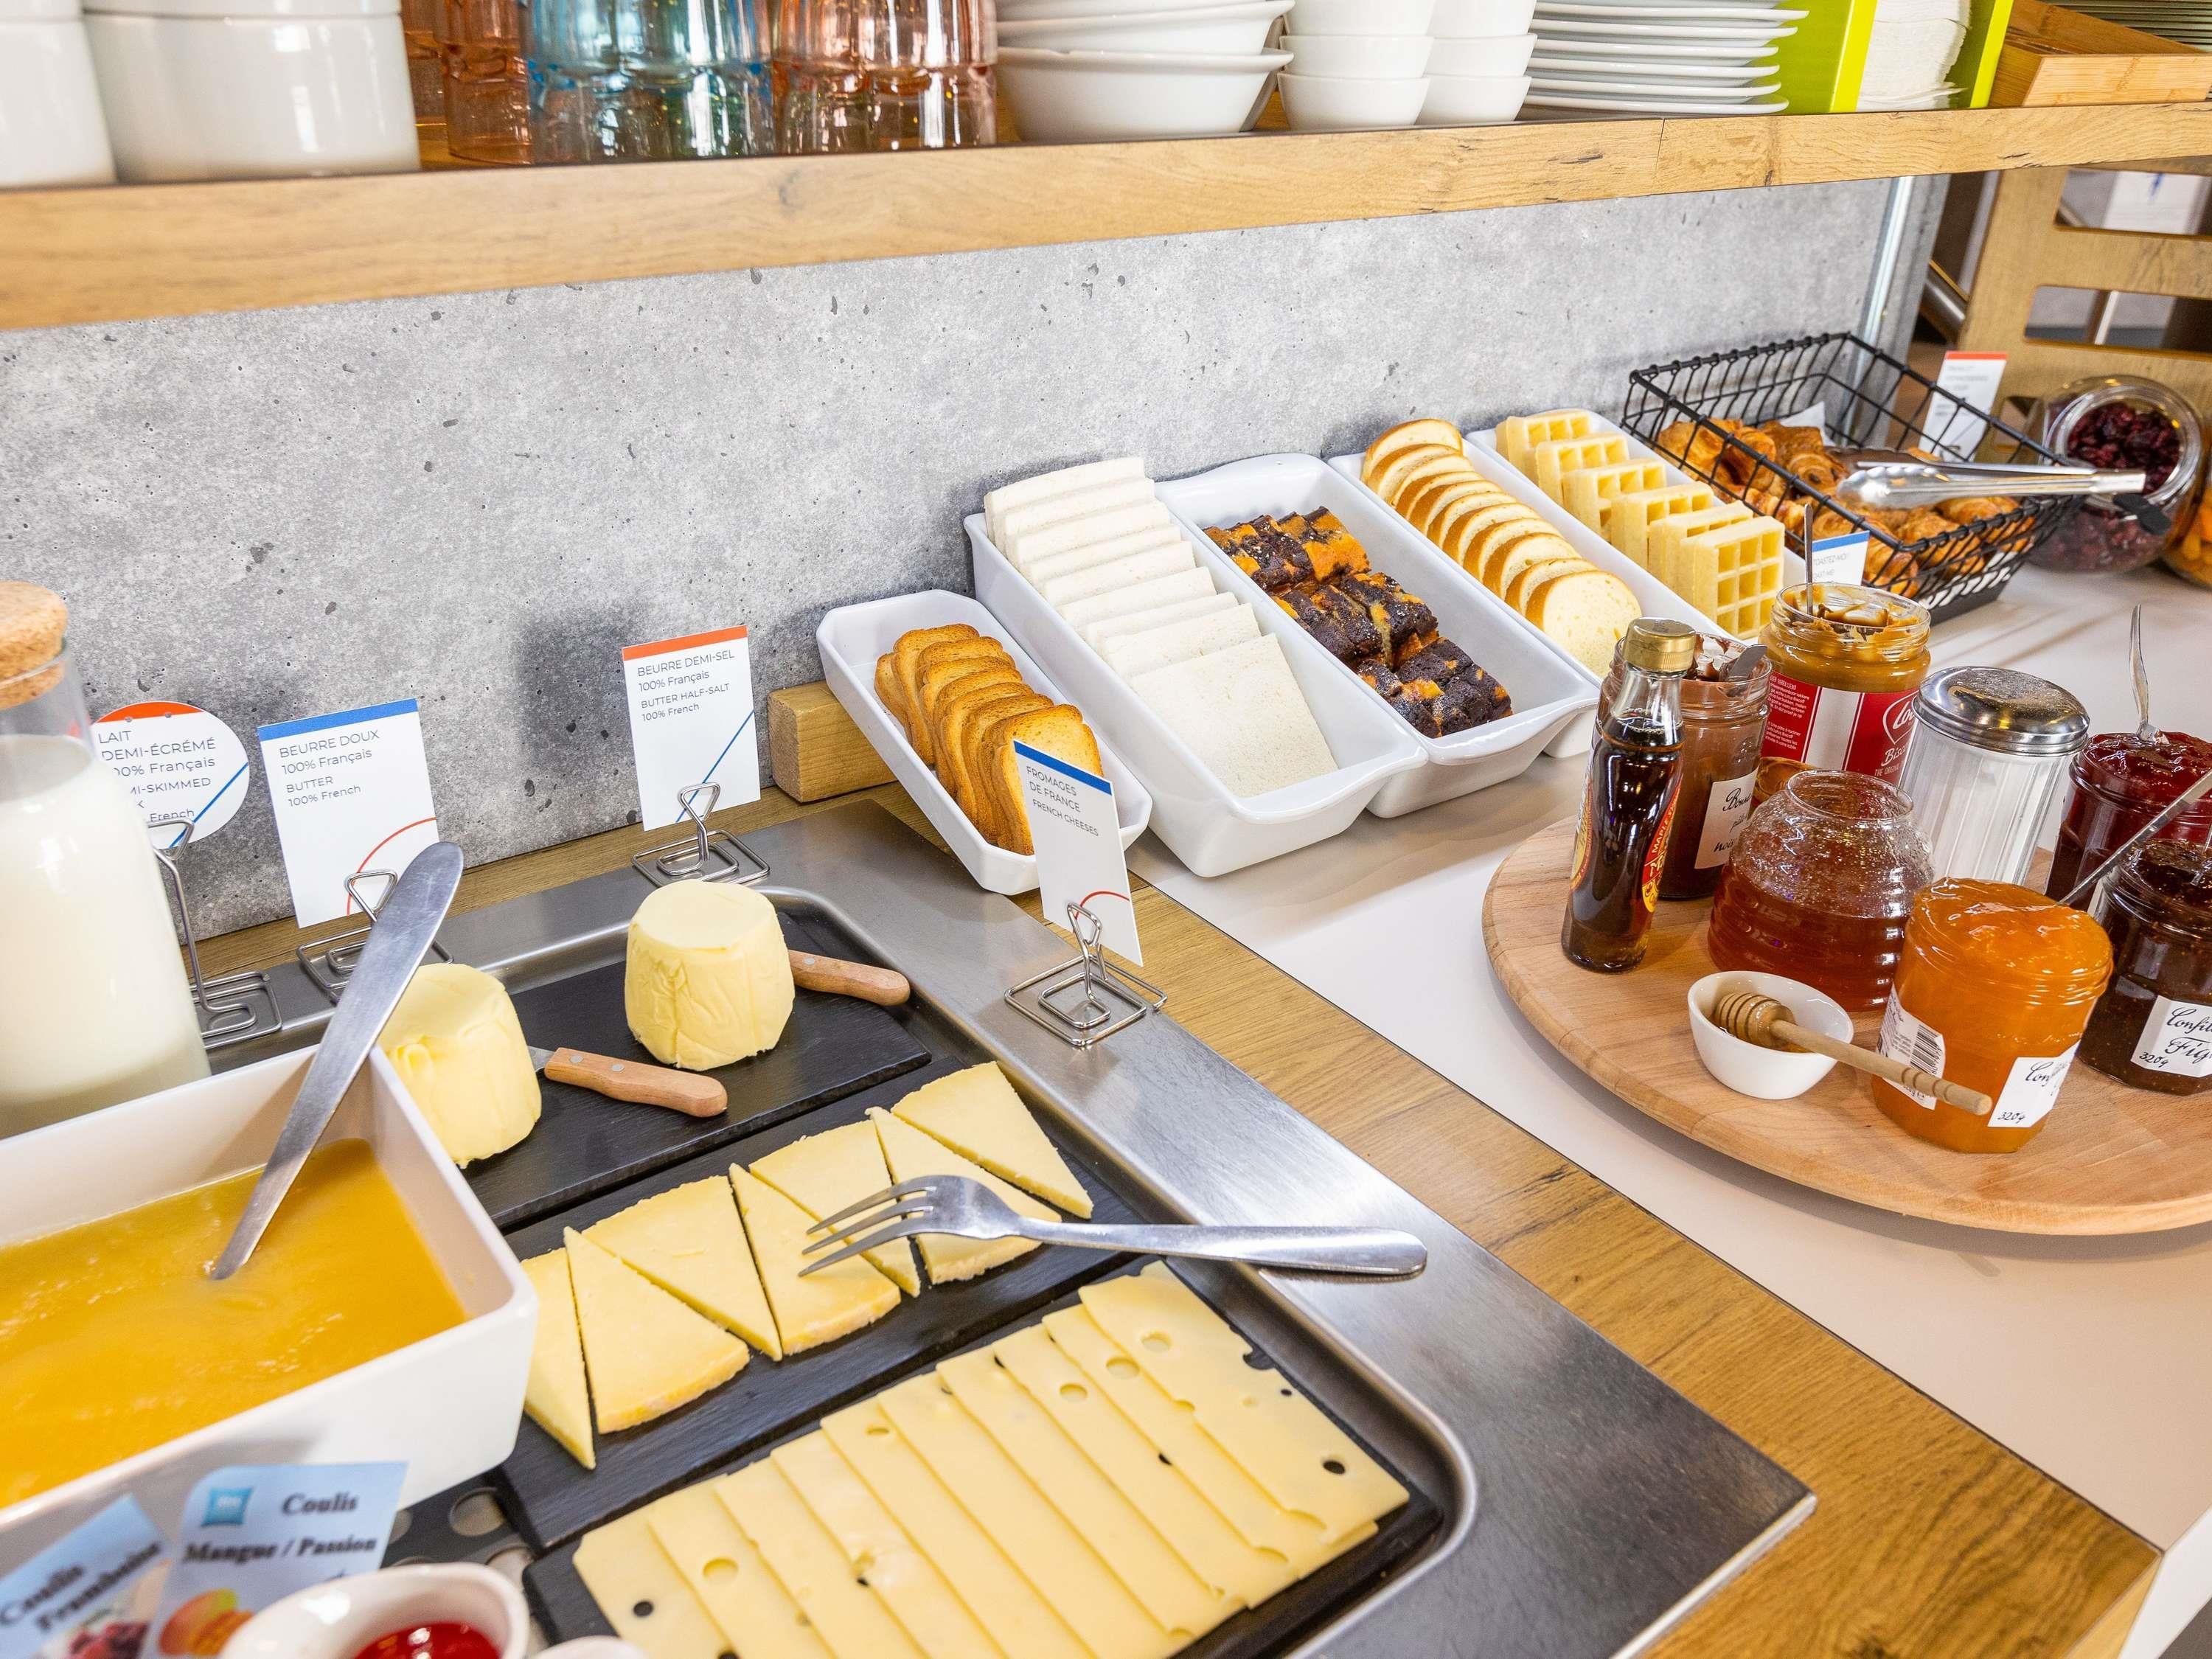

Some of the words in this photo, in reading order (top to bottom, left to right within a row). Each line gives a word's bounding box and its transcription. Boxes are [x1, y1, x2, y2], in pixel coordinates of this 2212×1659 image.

[638, 660, 683, 677] BEURRE
[685, 650, 735, 668] DEMI-SEL
[639, 679, 666, 692] 100%
[667, 670, 710, 686] Français
[641, 694, 678, 709] BUTTER
[681, 683, 730, 700] HALF-SALT
[642, 710, 666, 722] 100%
[668, 703, 700, 717] French
[98, 731, 131, 743] LAIT
[102, 737, 216, 761] DEMI-ÉCRÉMÉ
[279, 738, 337, 758] BEURRE
[339, 729, 380, 746] DOUX
[150, 757, 215, 773] Français
[282, 759, 317, 775] 100%
[319, 748, 372, 768] Français
[286, 776, 334, 793] BUTTER
[1026, 766, 1077, 796] FROMAGES
[288, 793, 319, 807] 100%
[321, 785, 361, 800] French
[1029, 781, 1043, 795] DE
[1044, 787, 1081, 813] FRANCE
[150, 808, 195, 823] French
[1032, 799, 1063, 820] FRENCH
[1065, 814, 1099, 836] CHEESES
[2165, 1037, 2212, 1064] Fig
[282, 1491, 360, 1514] Coulis
